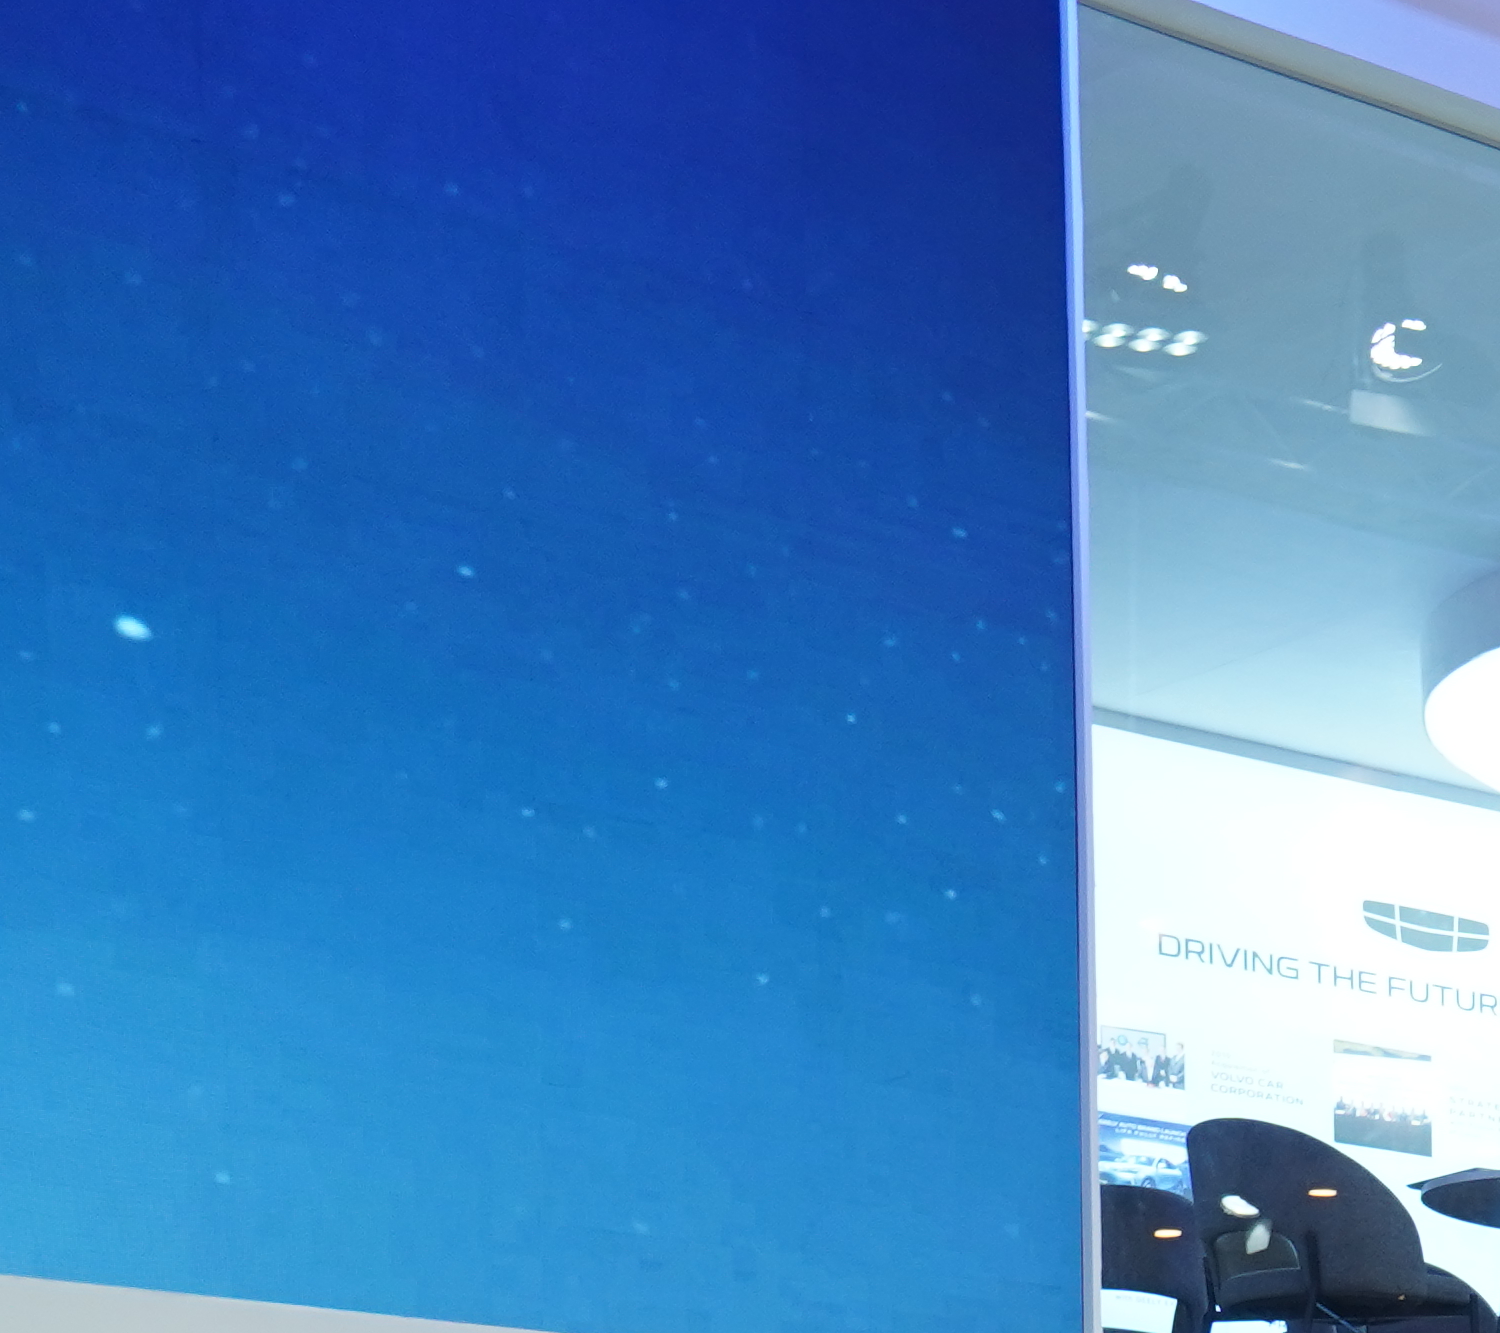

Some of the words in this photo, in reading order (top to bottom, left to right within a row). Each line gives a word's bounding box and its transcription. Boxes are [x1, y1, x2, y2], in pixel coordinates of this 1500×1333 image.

[1157, 933, 1300, 982] DRIVING
[1308, 960, 1378, 996] THE
[1211, 1070, 1254, 1085] VOLVO
[1258, 1078, 1284, 1089] CAR
[1210, 1083, 1304, 1105] CORPORATION
